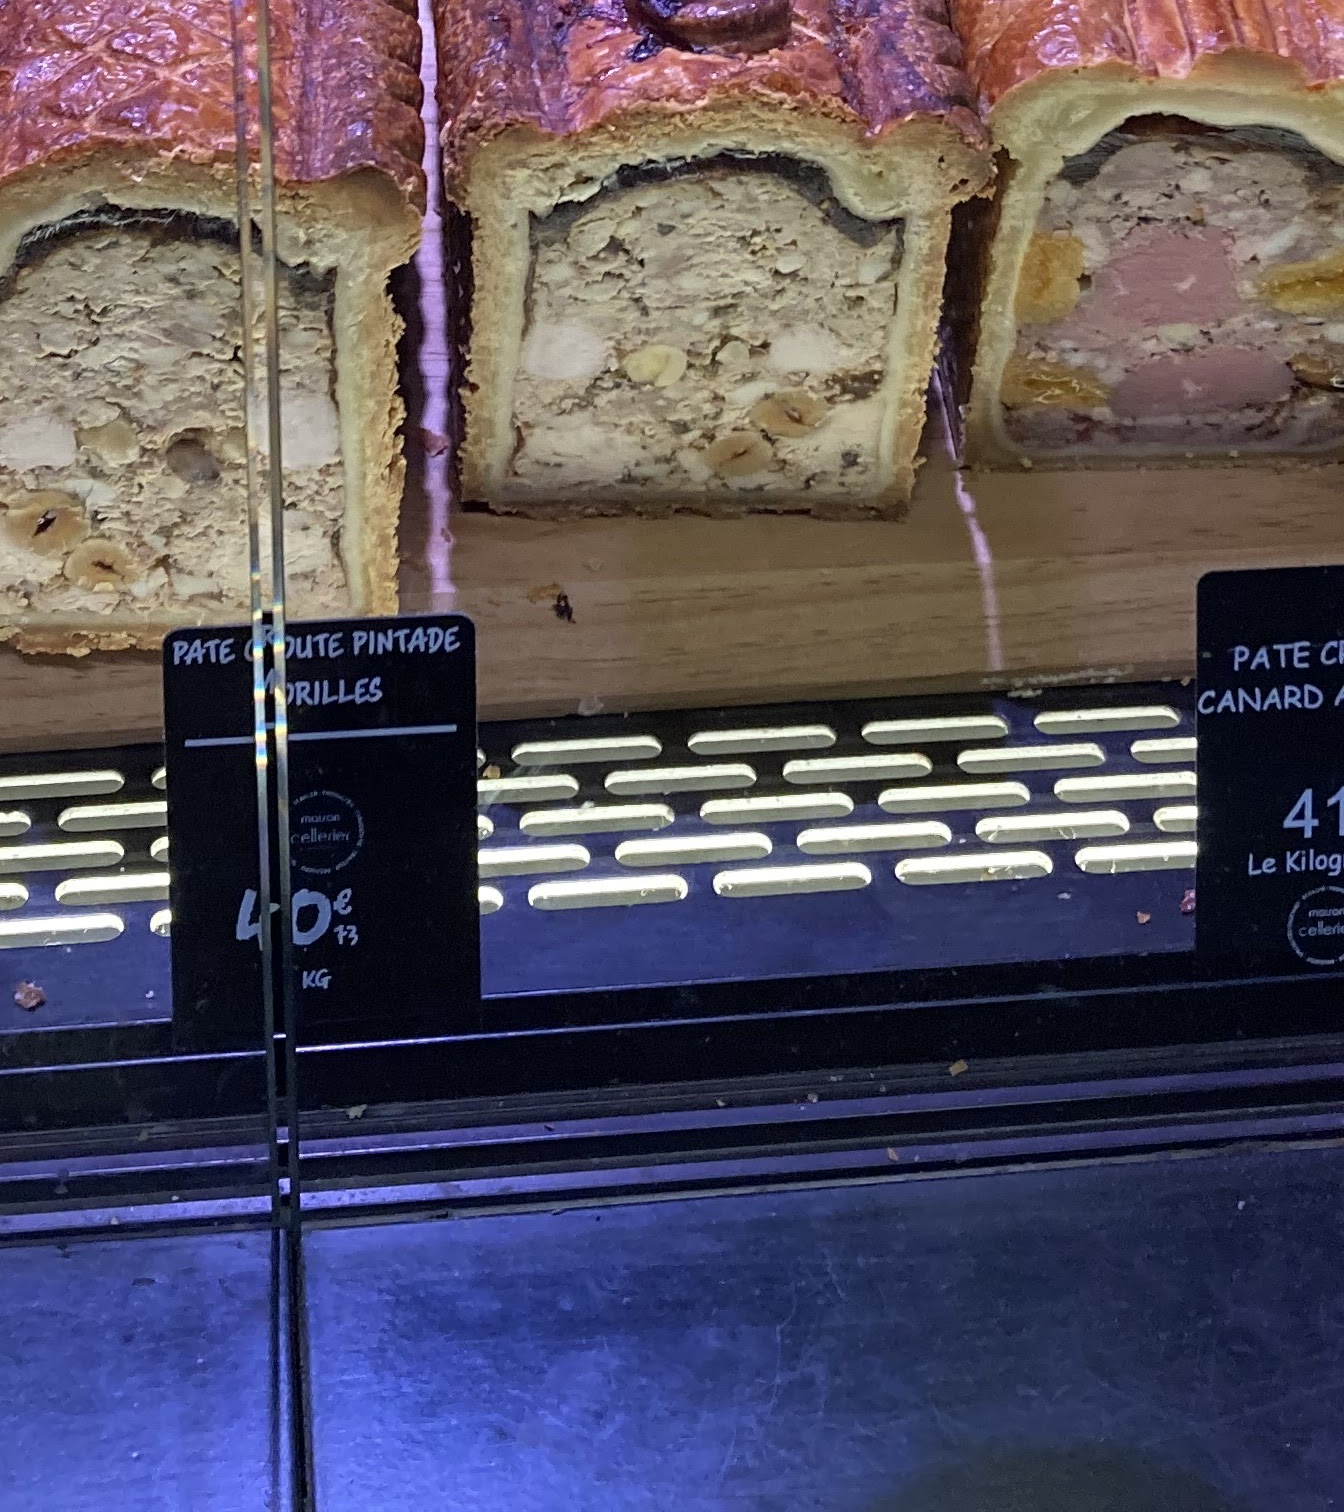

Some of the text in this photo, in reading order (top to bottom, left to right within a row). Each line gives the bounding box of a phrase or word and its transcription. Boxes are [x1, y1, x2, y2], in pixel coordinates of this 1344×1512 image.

[173, 639, 236, 665] PATE
[352, 626, 461, 655] PINTADE
[1233, 641, 1311, 672] PATE
[1197, 685, 1324, 715] CANARD
[1248, 851, 1276, 876] Le
[302, 969, 332, 989] KG
